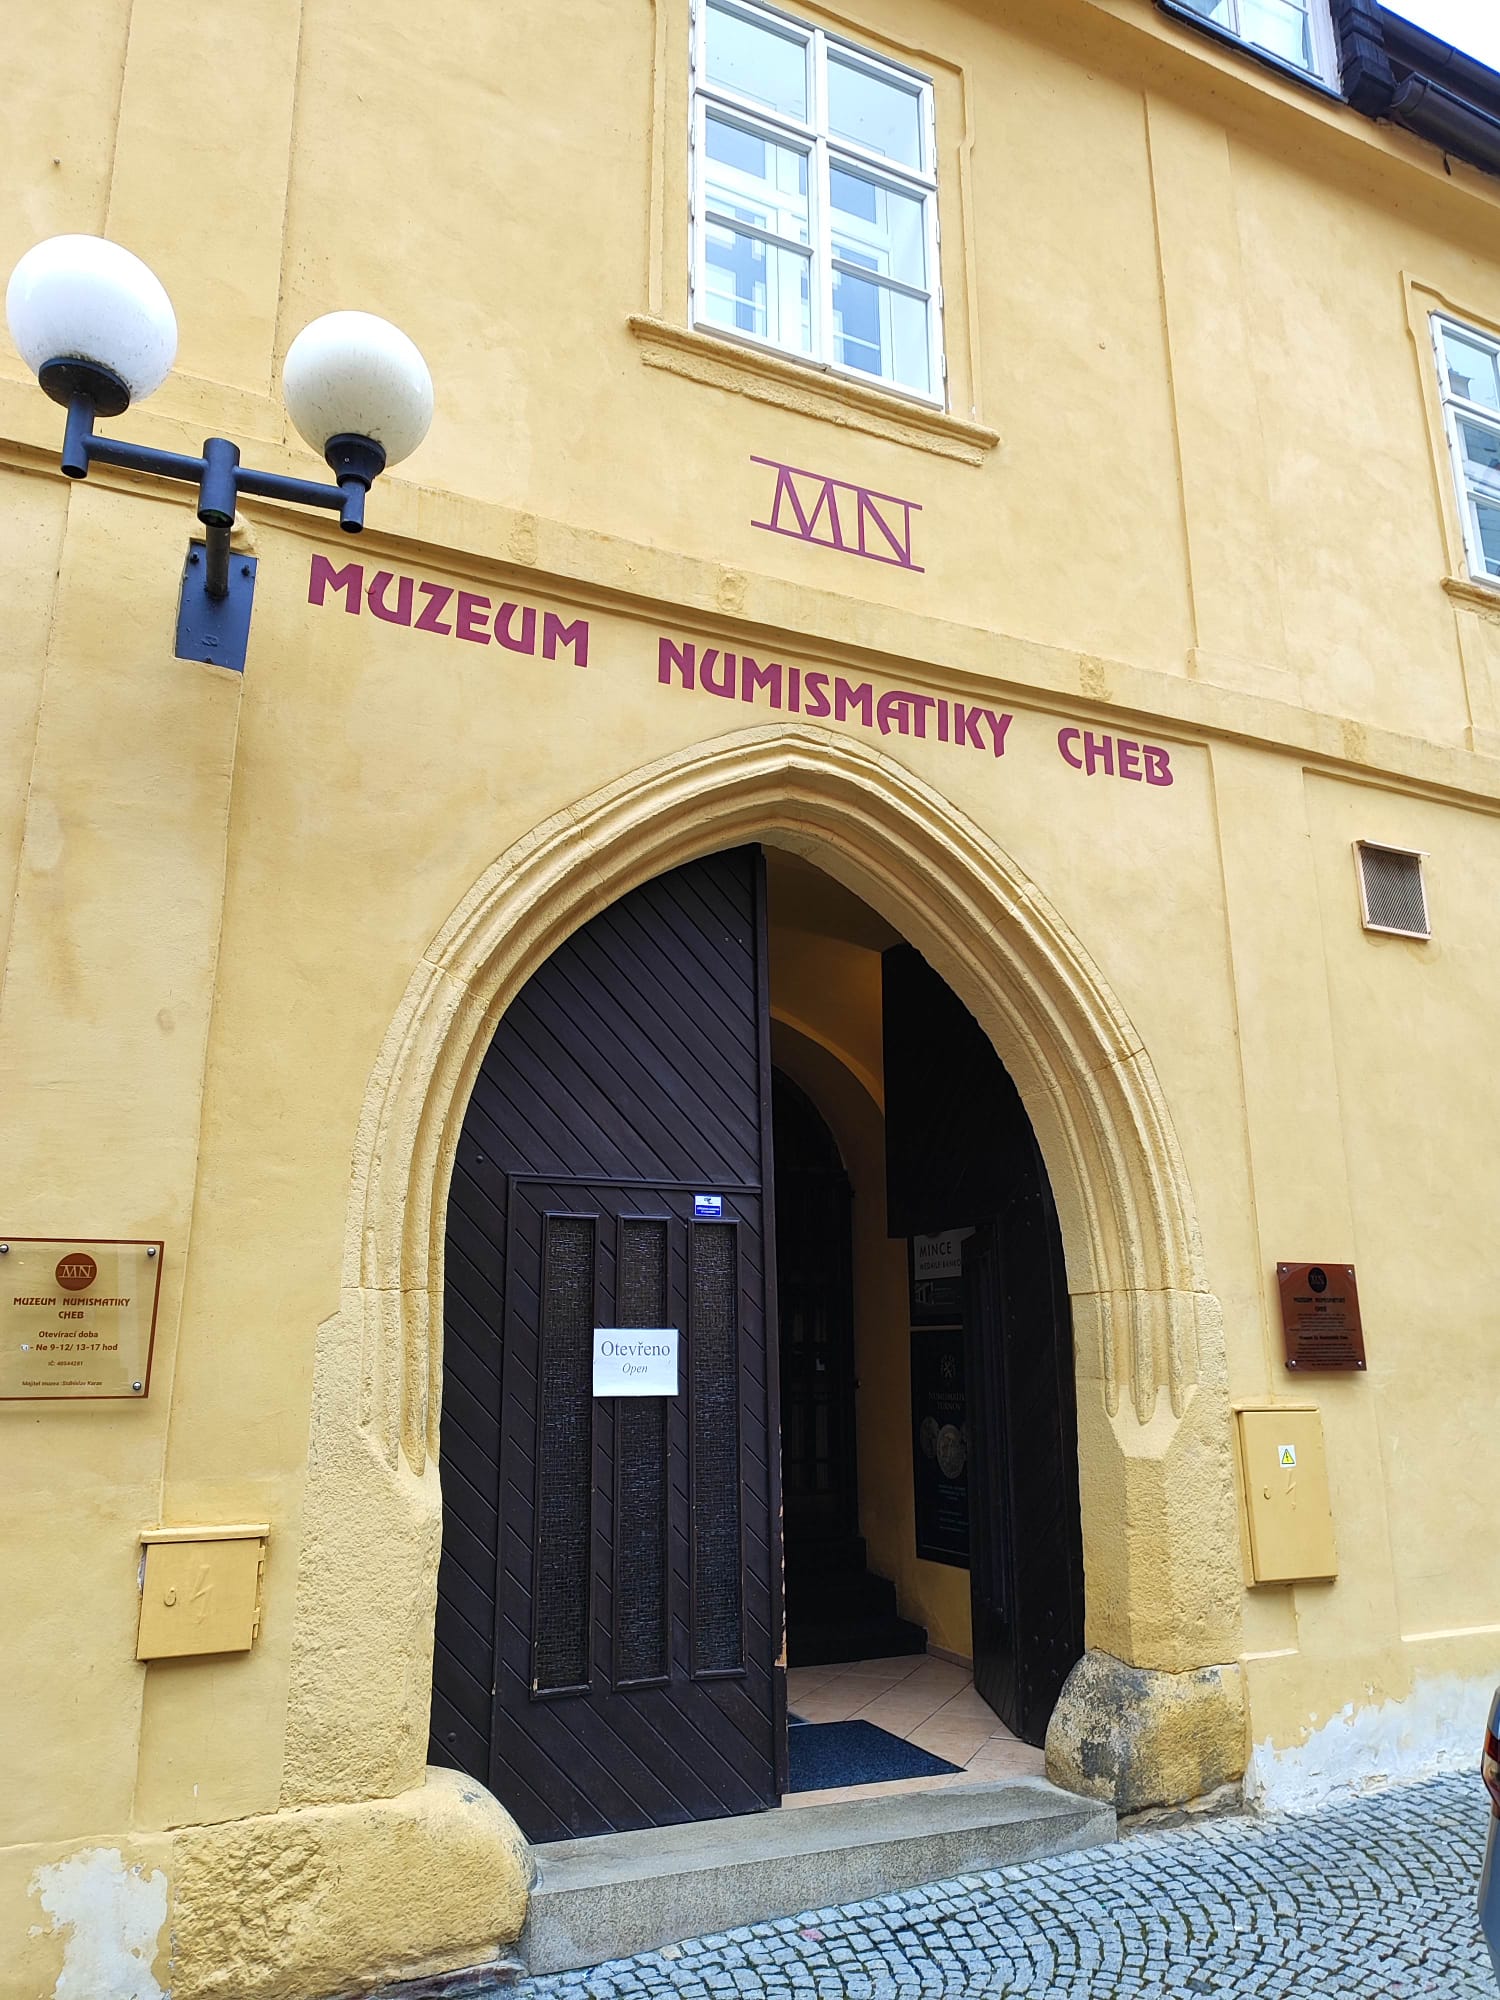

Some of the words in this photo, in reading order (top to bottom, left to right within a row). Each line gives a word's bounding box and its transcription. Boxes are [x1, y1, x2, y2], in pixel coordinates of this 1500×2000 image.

[751, 456, 924, 573] MN
[308, 554, 590, 667] MUZEUM
[658, 637, 1013, 757] NUMISMATIKY
[1057, 727, 1175, 787] CHEB
[920, 1241, 951, 1257] MINCE
[58, 1264, 94, 1278] MN
[13, 1297, 56, 1305] MUZEUM
[62, 1298, 130, 1306] NUMISMATIKY
[58, 1311, 84, 1319] CHEB
[38, 1329, 77, 1338] Otevírací
[102, 1343, 118, 1351] hod
[600, 1340, 671, 1357] Otevřeno
[622, 1362, 648, 1374] Open
